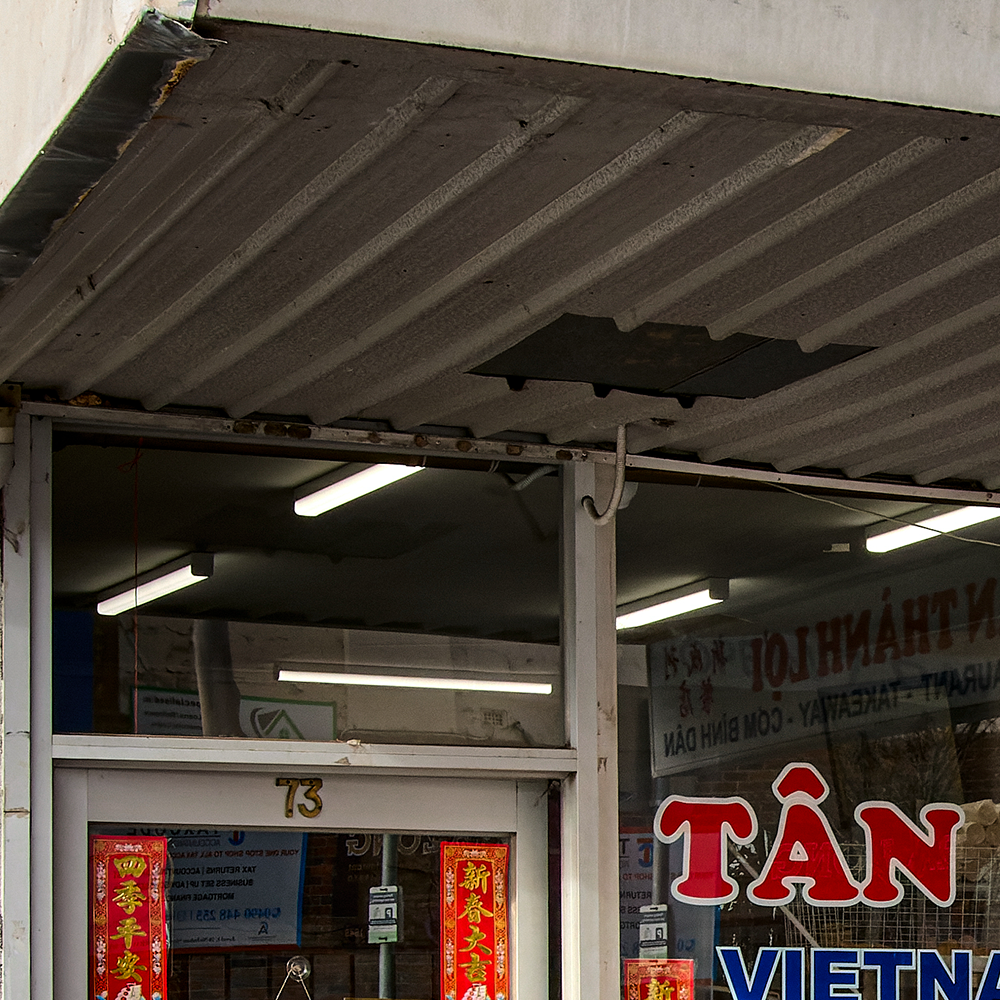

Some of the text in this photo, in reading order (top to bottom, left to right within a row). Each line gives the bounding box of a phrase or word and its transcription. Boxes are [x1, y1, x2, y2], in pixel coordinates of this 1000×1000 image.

[276, 778, 323, 819] 73
[653, 762, 965, 907] TÂN
[110, 855, 147, 982] 四季平安
[457, 861, 494, 983] 新春大吉
